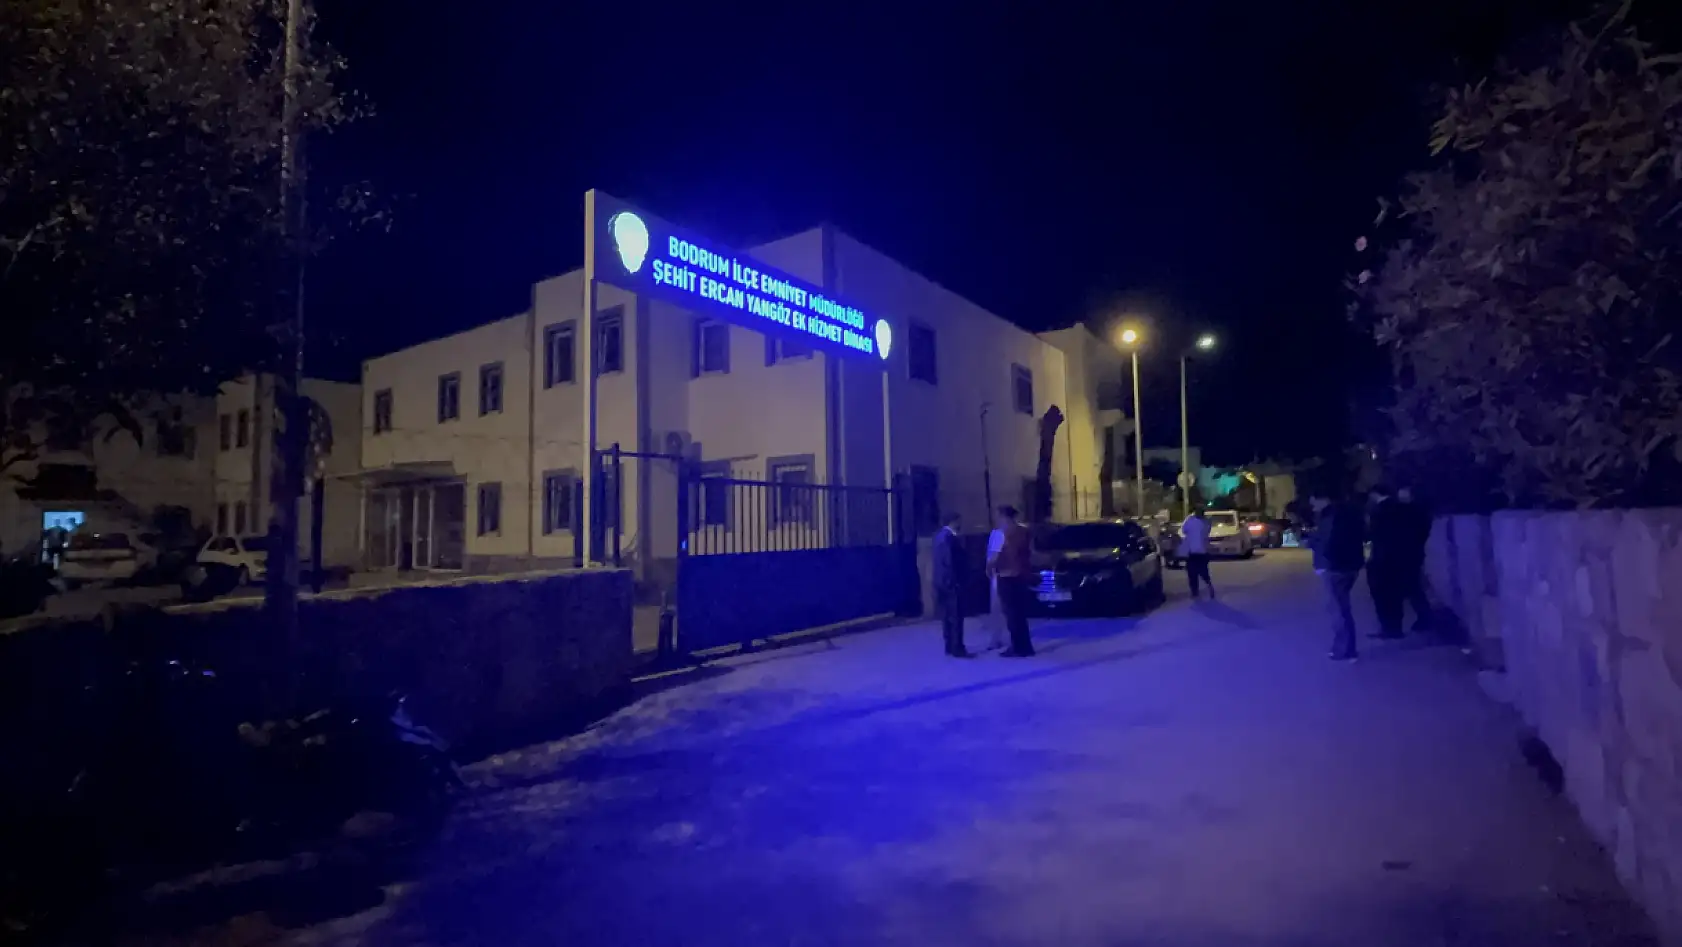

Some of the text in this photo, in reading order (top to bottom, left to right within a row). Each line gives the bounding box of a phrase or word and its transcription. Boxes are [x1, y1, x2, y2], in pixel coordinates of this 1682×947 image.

[653, 259, 873, 354] ŞEHİT ERCAN YANGÖZ EK HİZMET BİNASI
[669, 236, 864, 330] BODRUM İLÇE EMNİYET MÜDÜRLÜĞÜ
